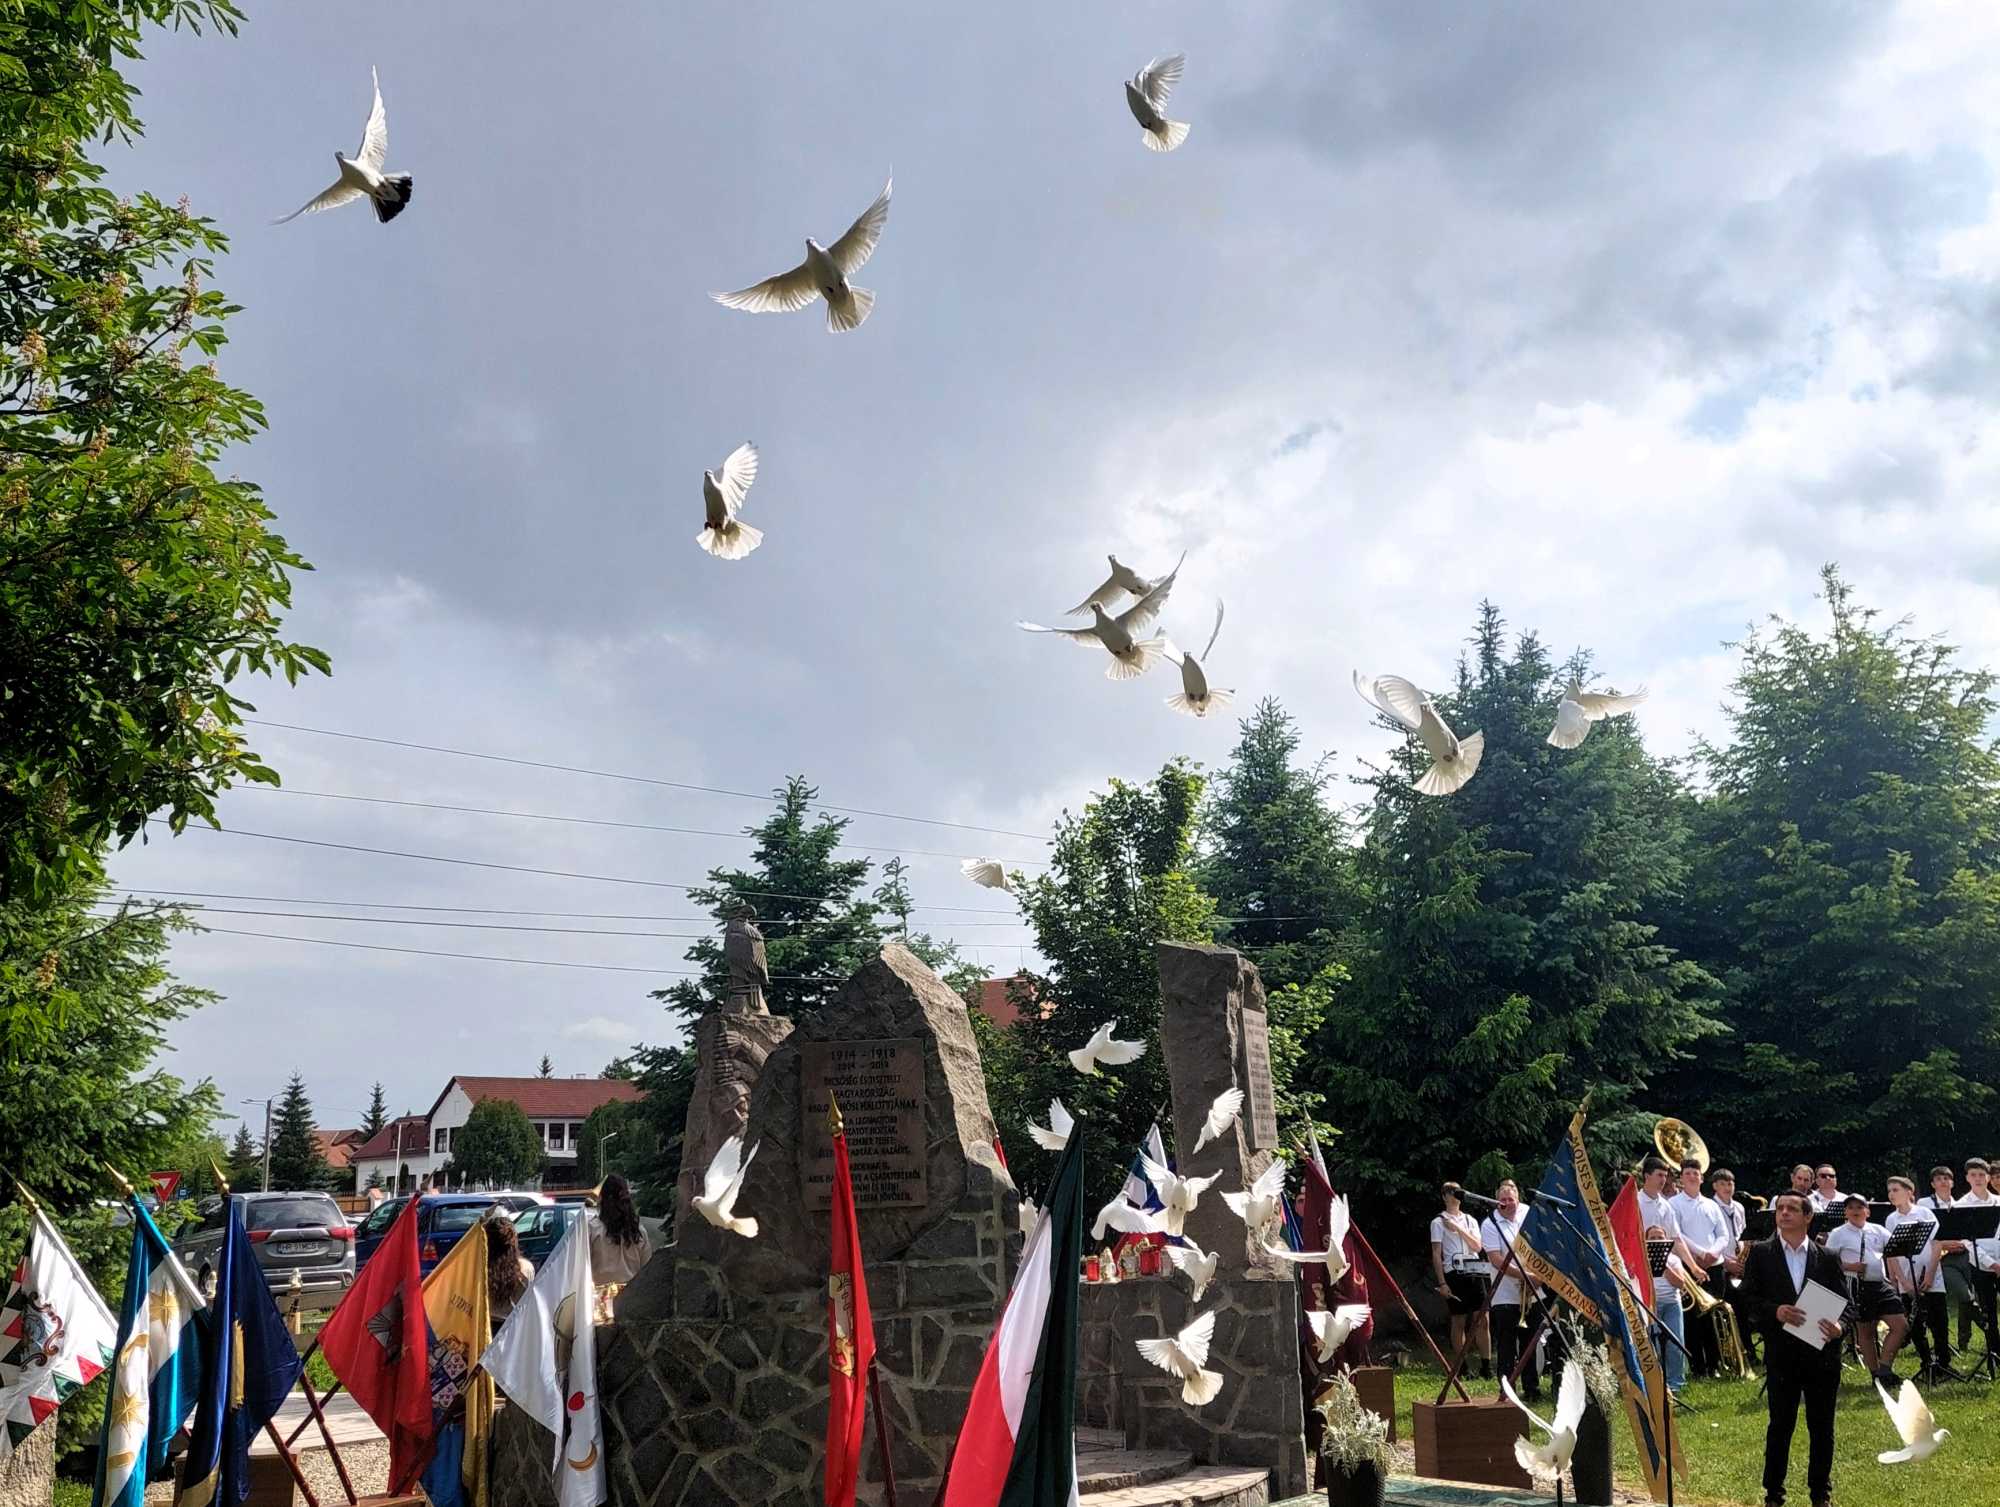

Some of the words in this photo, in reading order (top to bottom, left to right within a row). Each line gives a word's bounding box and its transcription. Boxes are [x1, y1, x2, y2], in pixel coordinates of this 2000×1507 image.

[832, 1050, 856, 1060] 1914
[871, 1048, 896, 1058] 1918
[1572, 1136, 1594, 1190] MOISES
[1620, 1283, 1655, 1374] EMENFALVA
